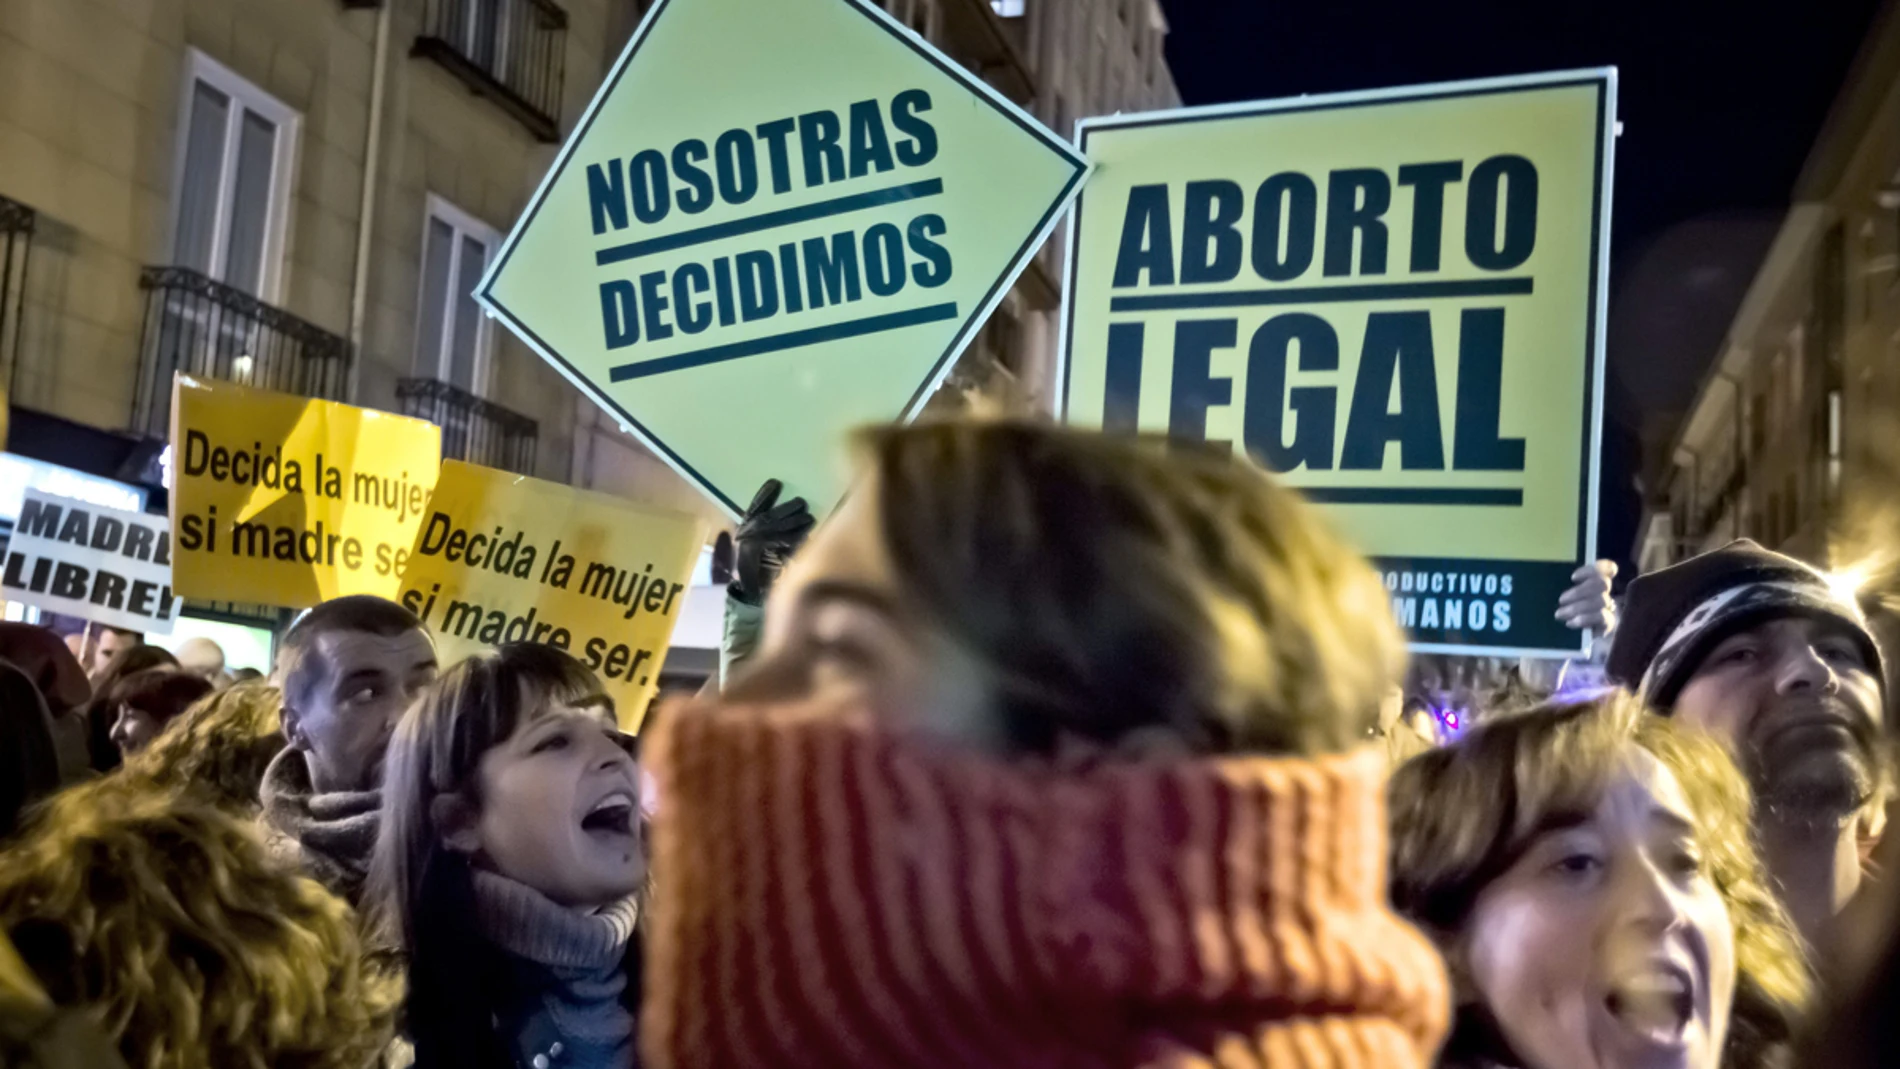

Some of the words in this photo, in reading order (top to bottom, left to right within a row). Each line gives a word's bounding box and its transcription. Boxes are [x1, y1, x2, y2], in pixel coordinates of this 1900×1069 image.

[586, 88, 938, 236] NOSOTRAS
[1111, 153, 1539, 285] ABORTO
[599, 213, 953, 350] DECIDIMOS
[1102, 306, 1526, 474] LEGAL
[184, 428, 302, 494] Decida
[315, 453, 342, 499] la
[179, 505, 218, 552] si
[232, 520, 363, 571] madre
[374, 542, 412, 580] se
[419, 511, 537, 580] Decida
[540, 539, 576, 590] la
[578, 557, 684, 620] mujer
[1376, 570, 1513, 596] ODUCTIVOS
[401, 583, 441, 624] si
[439, 598, 571, 651] madre
[581, 635, 653, 686] ser.
[1392, 597, 1511, 632] MANOS
